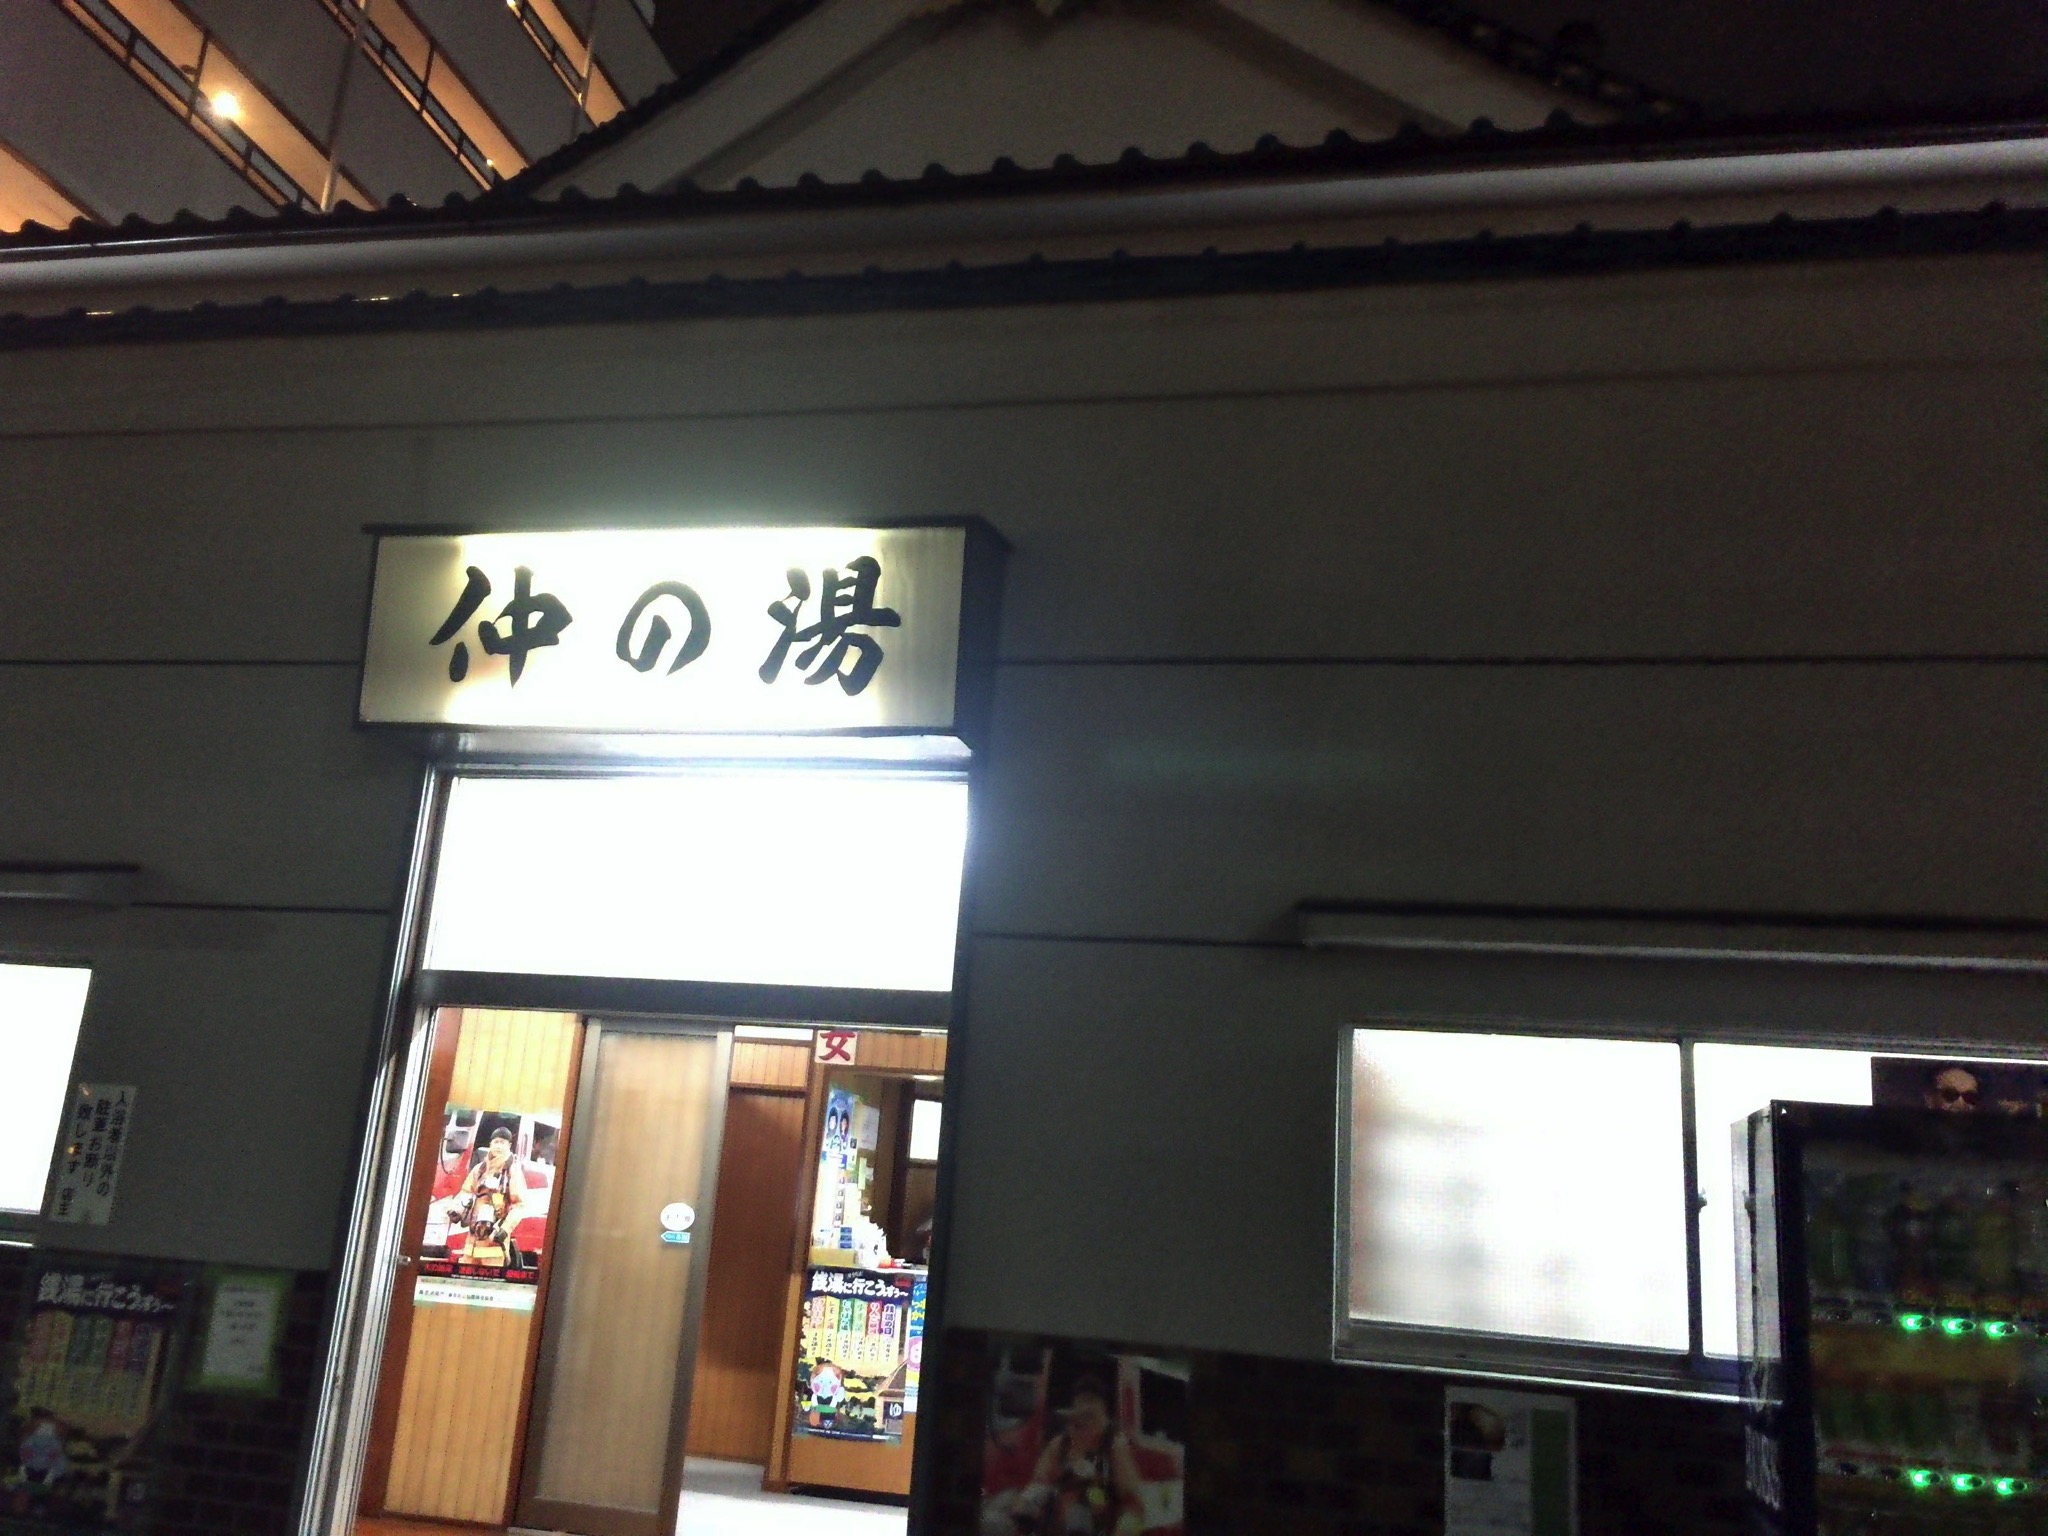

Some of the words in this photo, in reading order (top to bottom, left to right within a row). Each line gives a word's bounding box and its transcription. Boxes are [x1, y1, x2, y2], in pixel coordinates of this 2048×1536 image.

[429, 555, 901, 697] 仲の湯
[818, 1031, 856, 1062] 女
